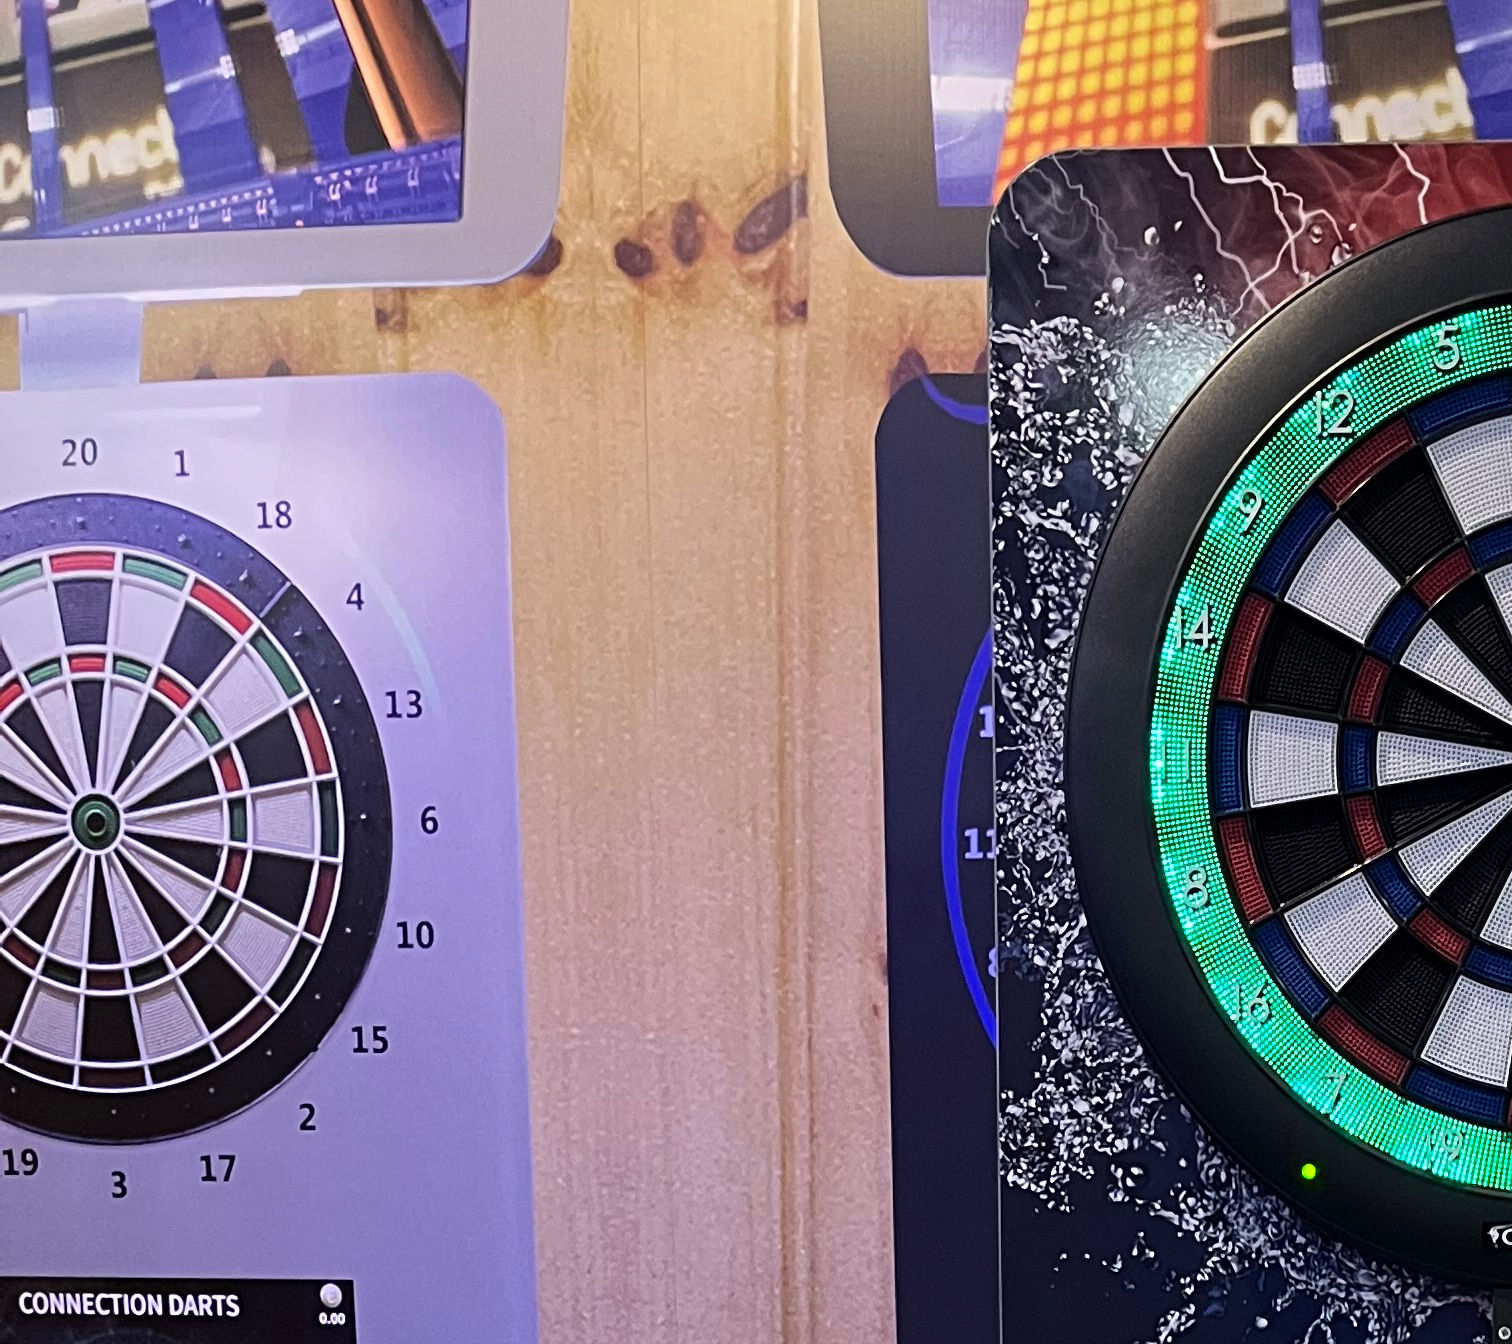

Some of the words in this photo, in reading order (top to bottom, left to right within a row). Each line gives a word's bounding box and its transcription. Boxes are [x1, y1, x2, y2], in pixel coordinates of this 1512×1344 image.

[1433, 326, 1460, 370] 5
[1314, 389, 1356, 436] 12
[62, 437, 98, 467] 20
[174, 450, 190, 477] 1
[256, 501, 292, 529] 18
[1238, 489, 1262, 532] 9
[345, 582, 364, 611] 4
[1174, 604, 1213, 649] 14
[385, 690, 423, 719] 13
[420, 806, 439, 834] 6
[1184, 866, 1209, 909] 8
[396, 921, 434, 949] 10
[1231, 982, 1271, 1024] 16
[351, 1025, 389, 1053] 15
[1323, 1072, 1347, 1116] 7
[299, 1103, 316, 1131] 2
[2, 1148, 38, 1177] 19
[200, 1154, 236, 1182] 17
[110, 1171, 128, 1199] 3
[19, 1291, 163, 1315] CONNECTION
[169, 1294, 240, 1317] DARTS
[319, 1312, 346, 1325] 0.00
